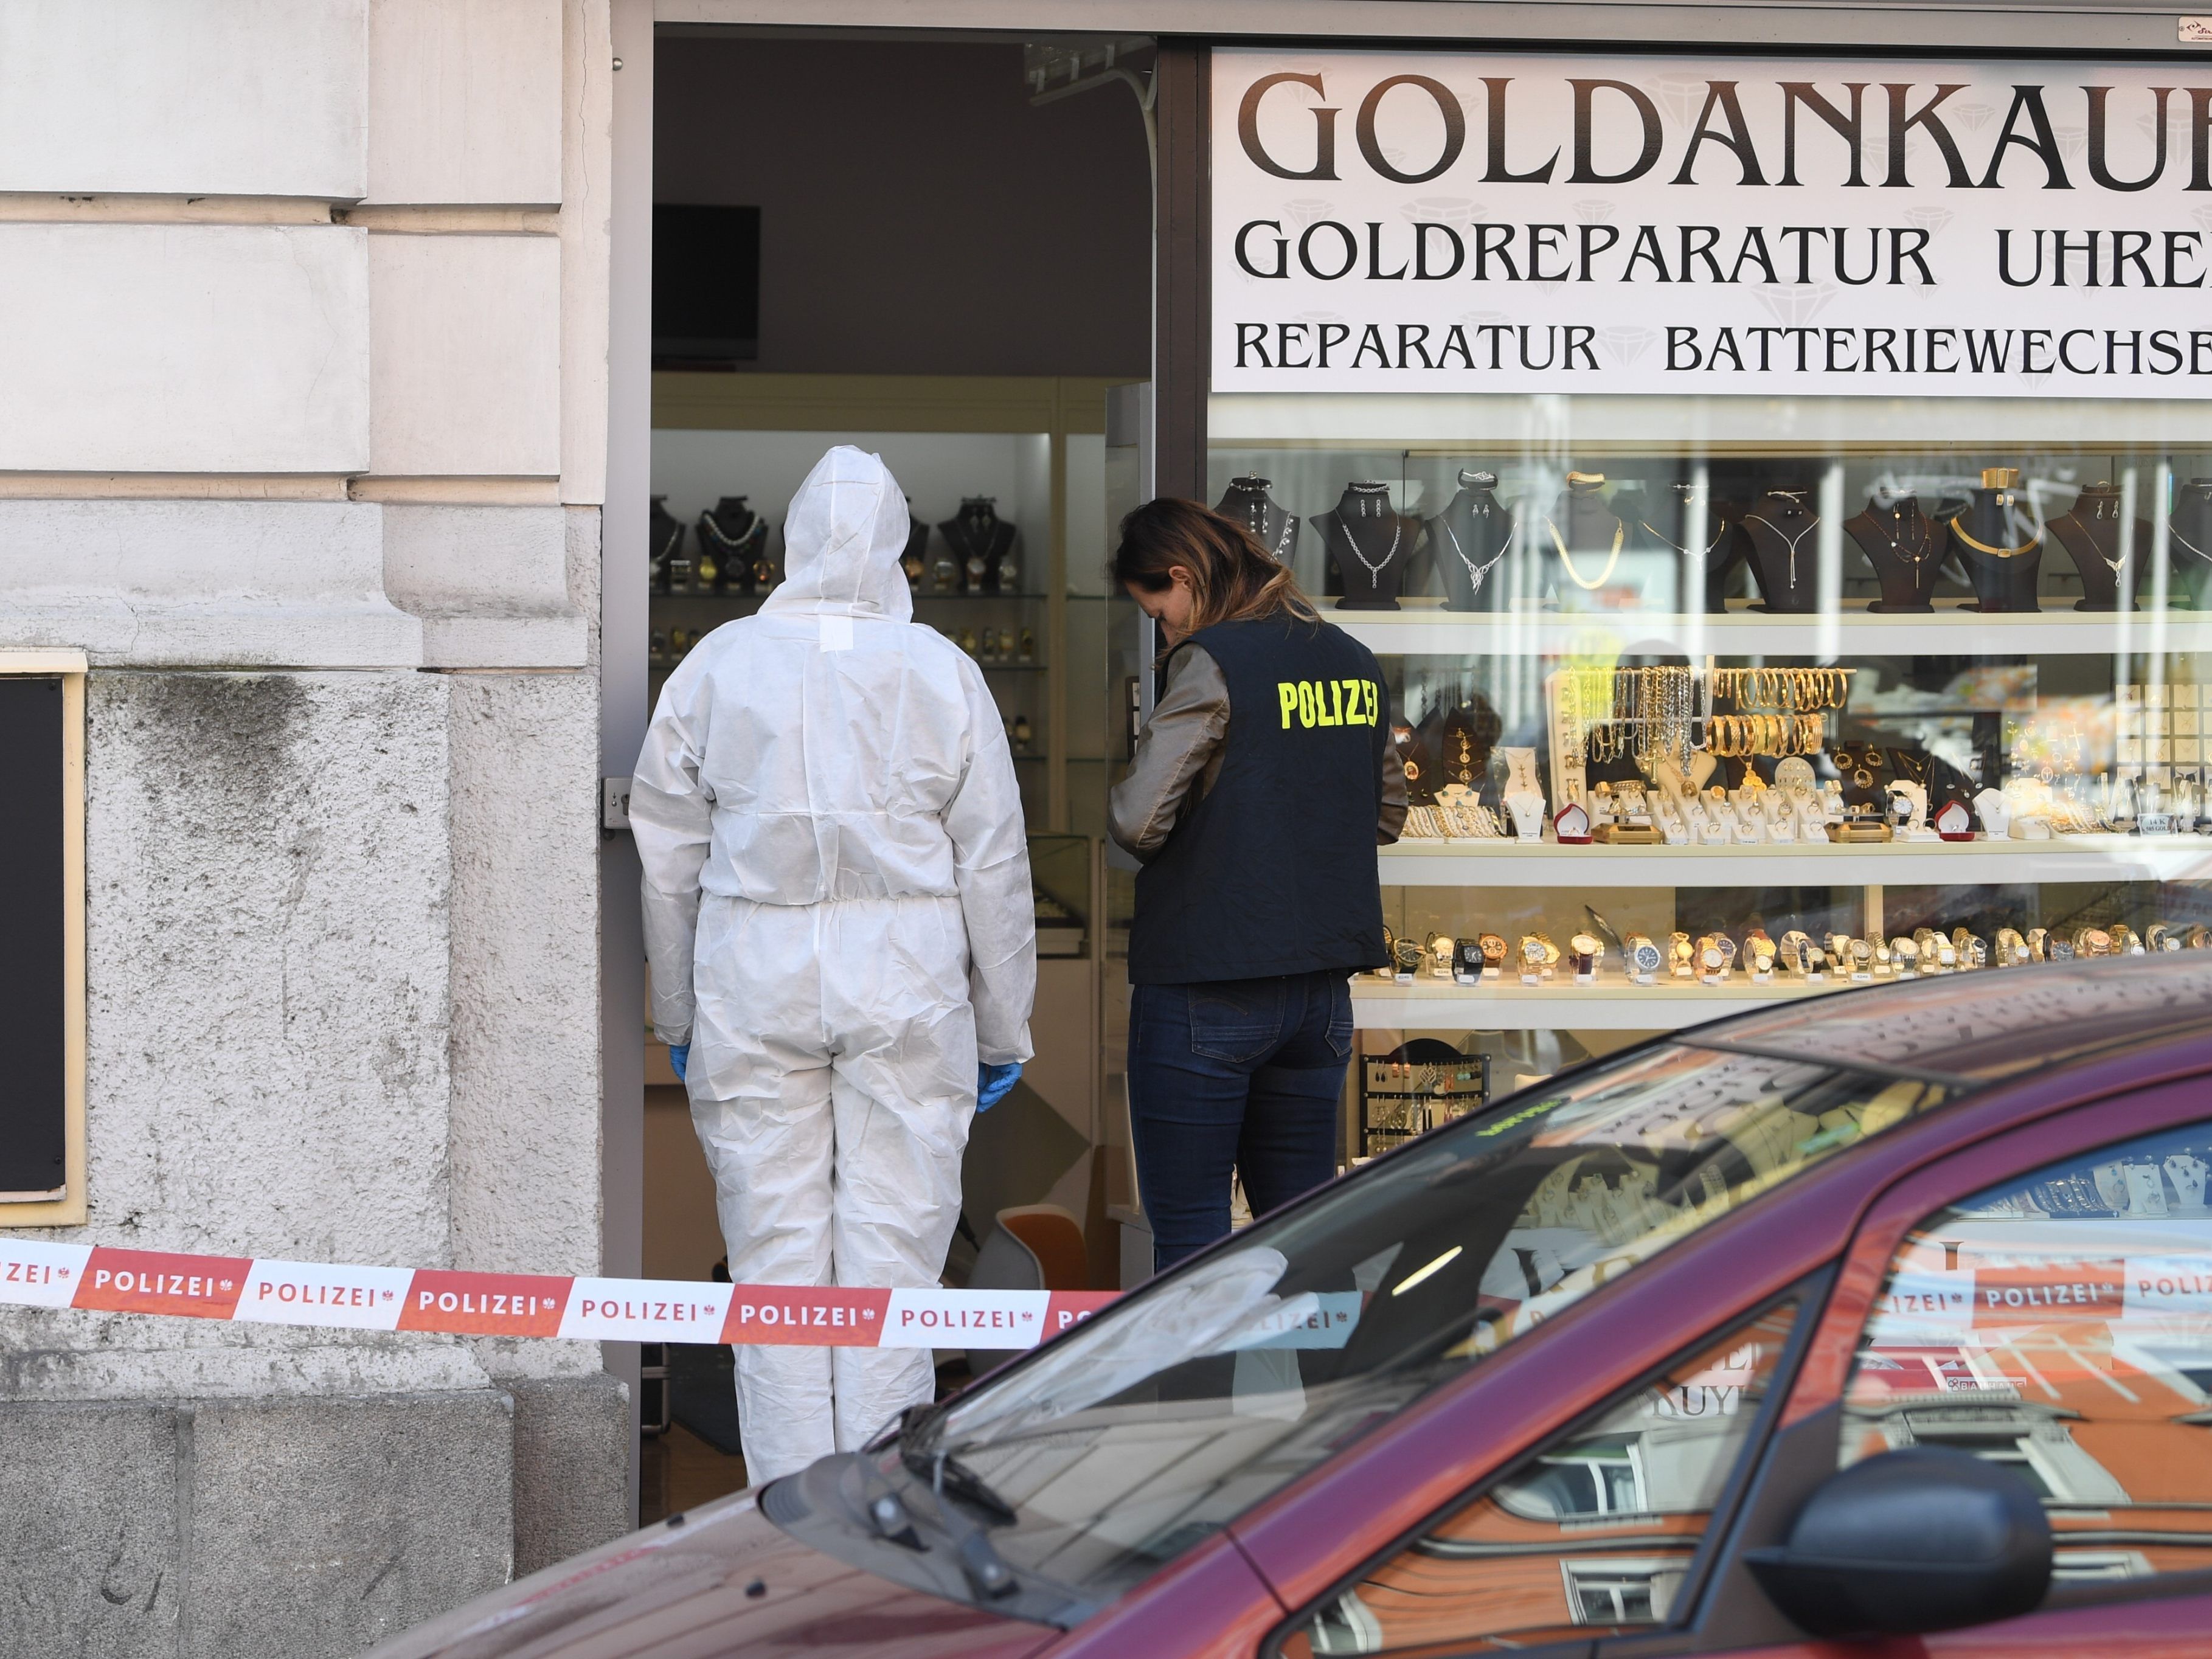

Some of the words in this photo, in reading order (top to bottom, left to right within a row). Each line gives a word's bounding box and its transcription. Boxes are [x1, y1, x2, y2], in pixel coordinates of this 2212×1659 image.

[1235, 220, 1938, 286] GOLDREPARATUR
[1995, 229, 2212, 288] UHRE
[1234, 322, 1601, 370] REPARATUR
[1664, 327, 2212, 375] BATTERIEWECHSE
[1278, 679, 1378, 729] POLIZEI
[0, 1262, 50, 1284] ZEI
[95, 1269, 213, 1297] POLIZEI
[258, 1282, 375, 1307] POLIZEI
[419, 1291, 536, 1315] POLIZEI
[582, 1300, 696, 1321] POLIZEI
[741, 1304, 856, 1327] POLIZEI
[901, 1309, 1015, 1328] POLIZEI
[1985, 1283, 2099, 1309] POLIZEI
